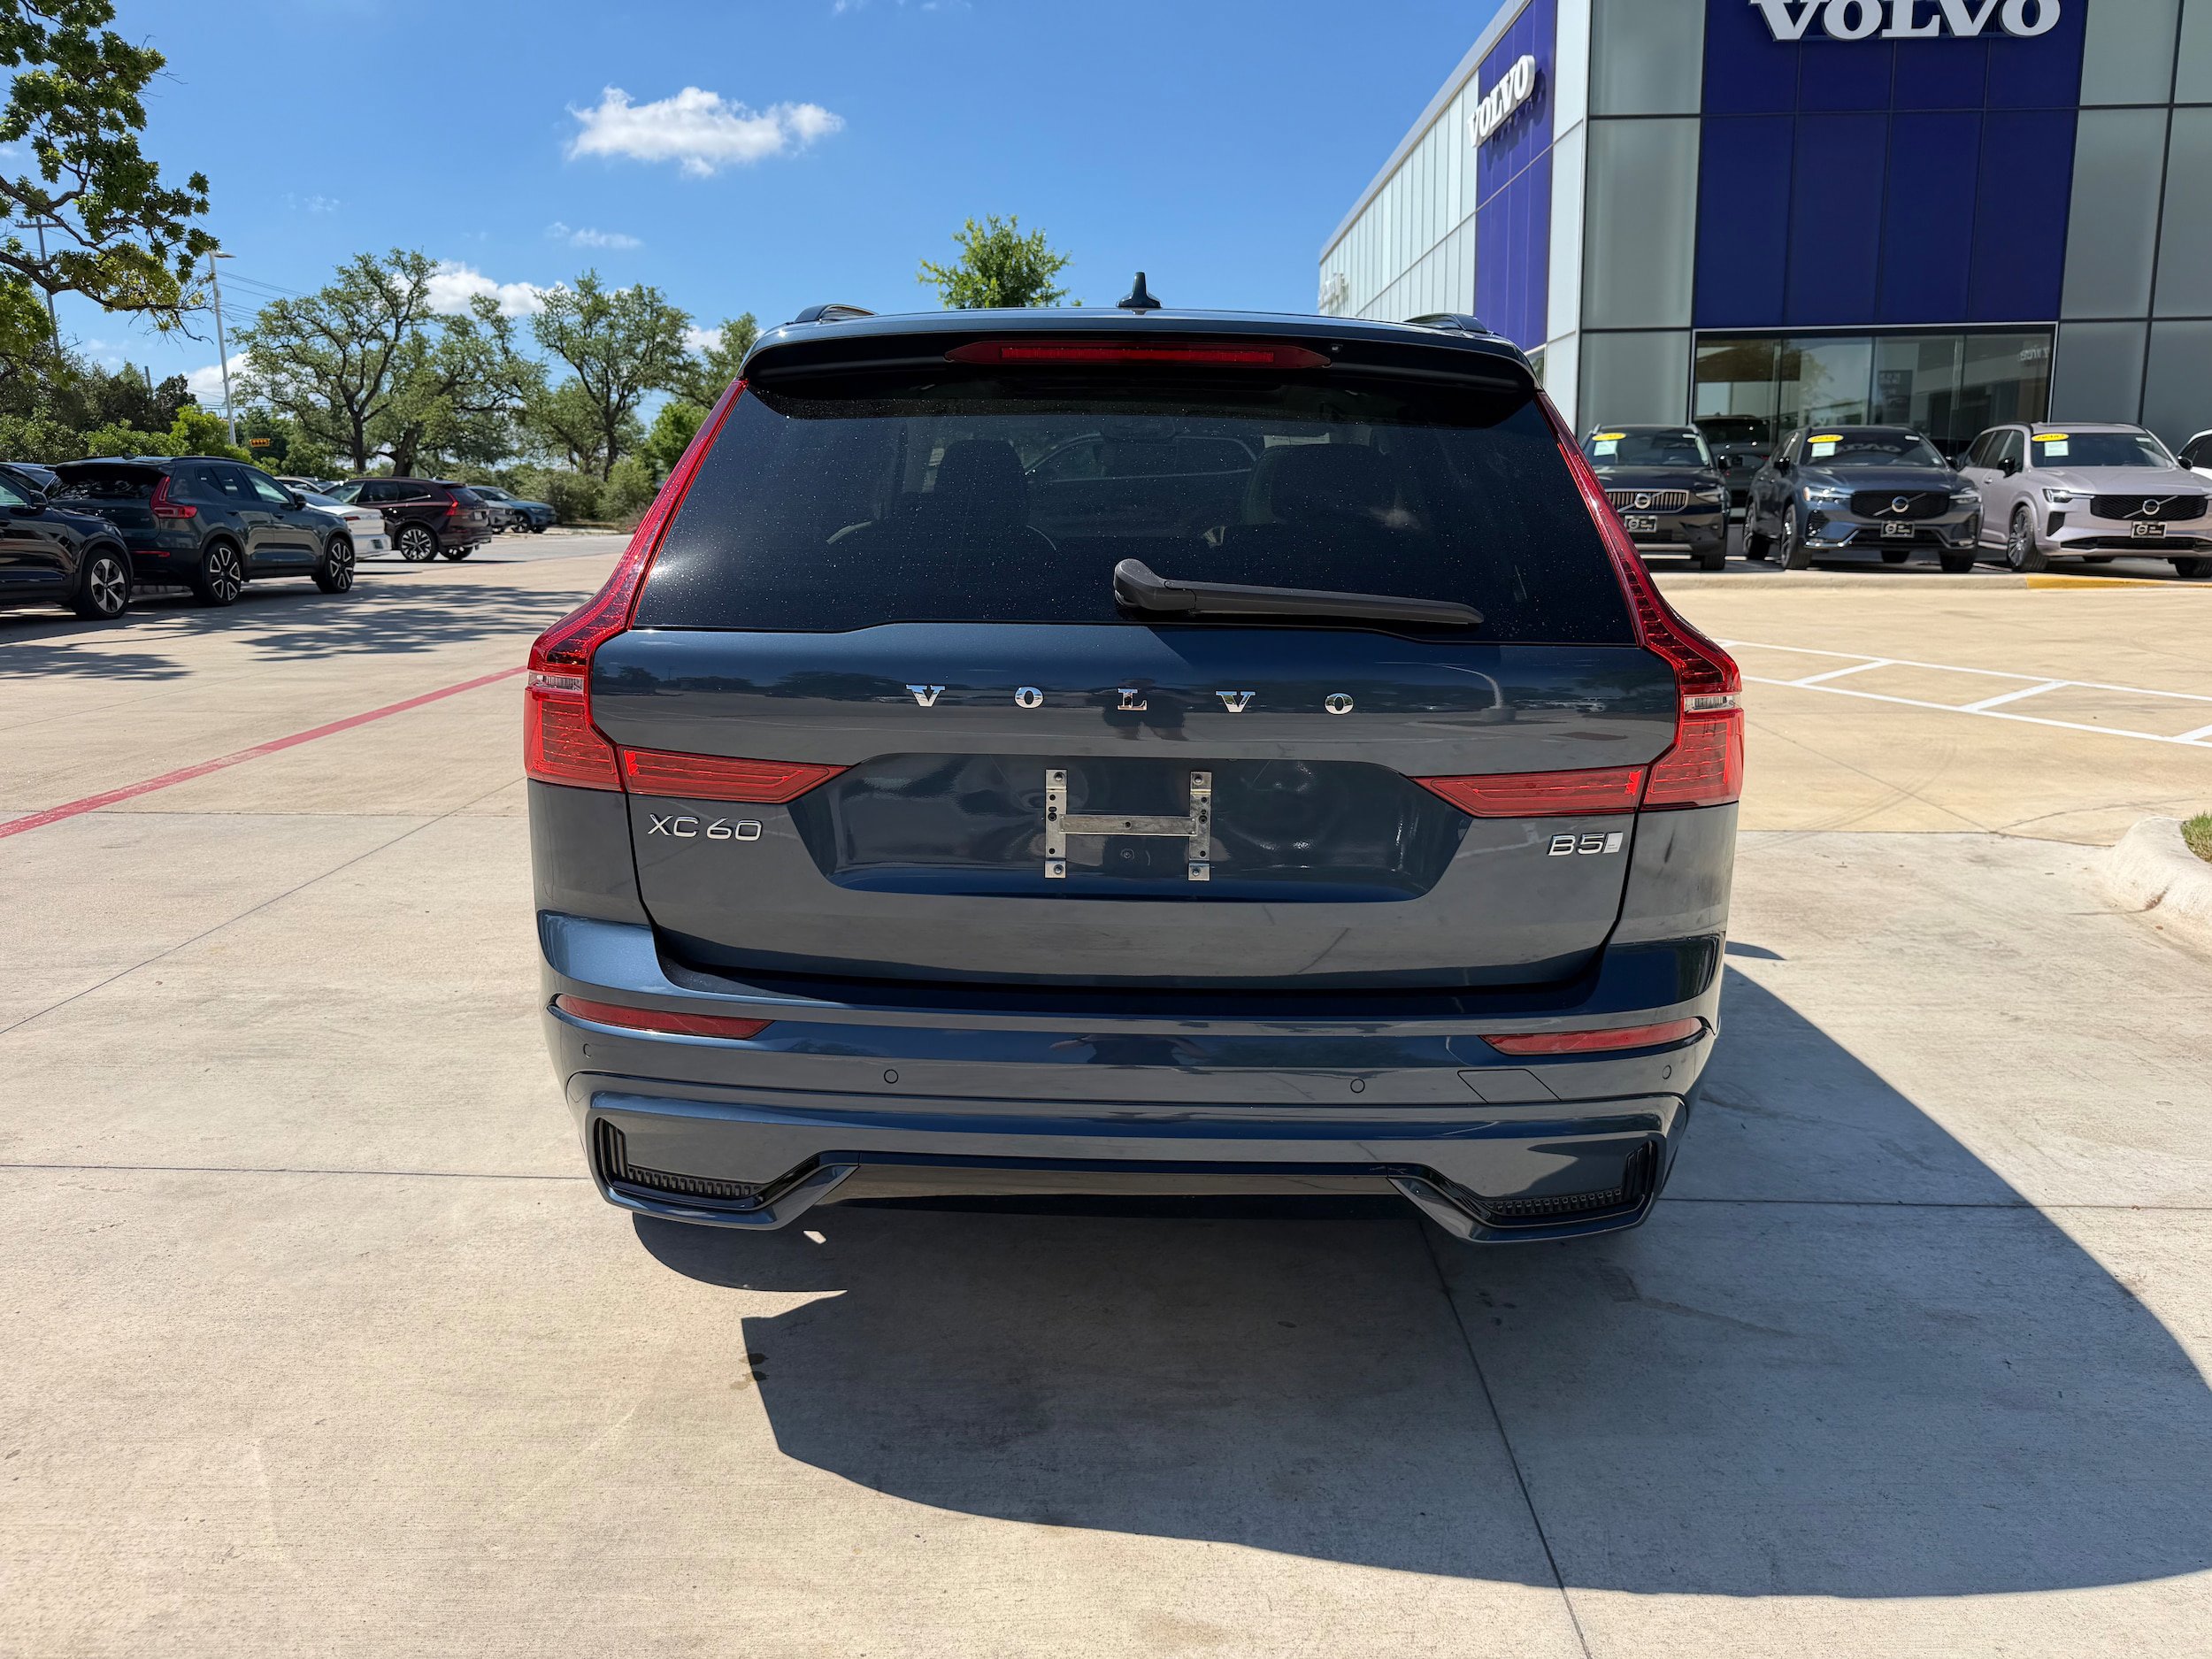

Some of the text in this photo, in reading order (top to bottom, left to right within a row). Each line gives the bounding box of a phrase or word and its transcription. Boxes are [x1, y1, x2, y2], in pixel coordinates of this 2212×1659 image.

[1750, 0, 2061, 40] VOLVO
[1468, 55, 1533, 148] VOLVO
[905, 684, 1355, 715] VOLVO
[1548, 833, 1604, 856] B5
